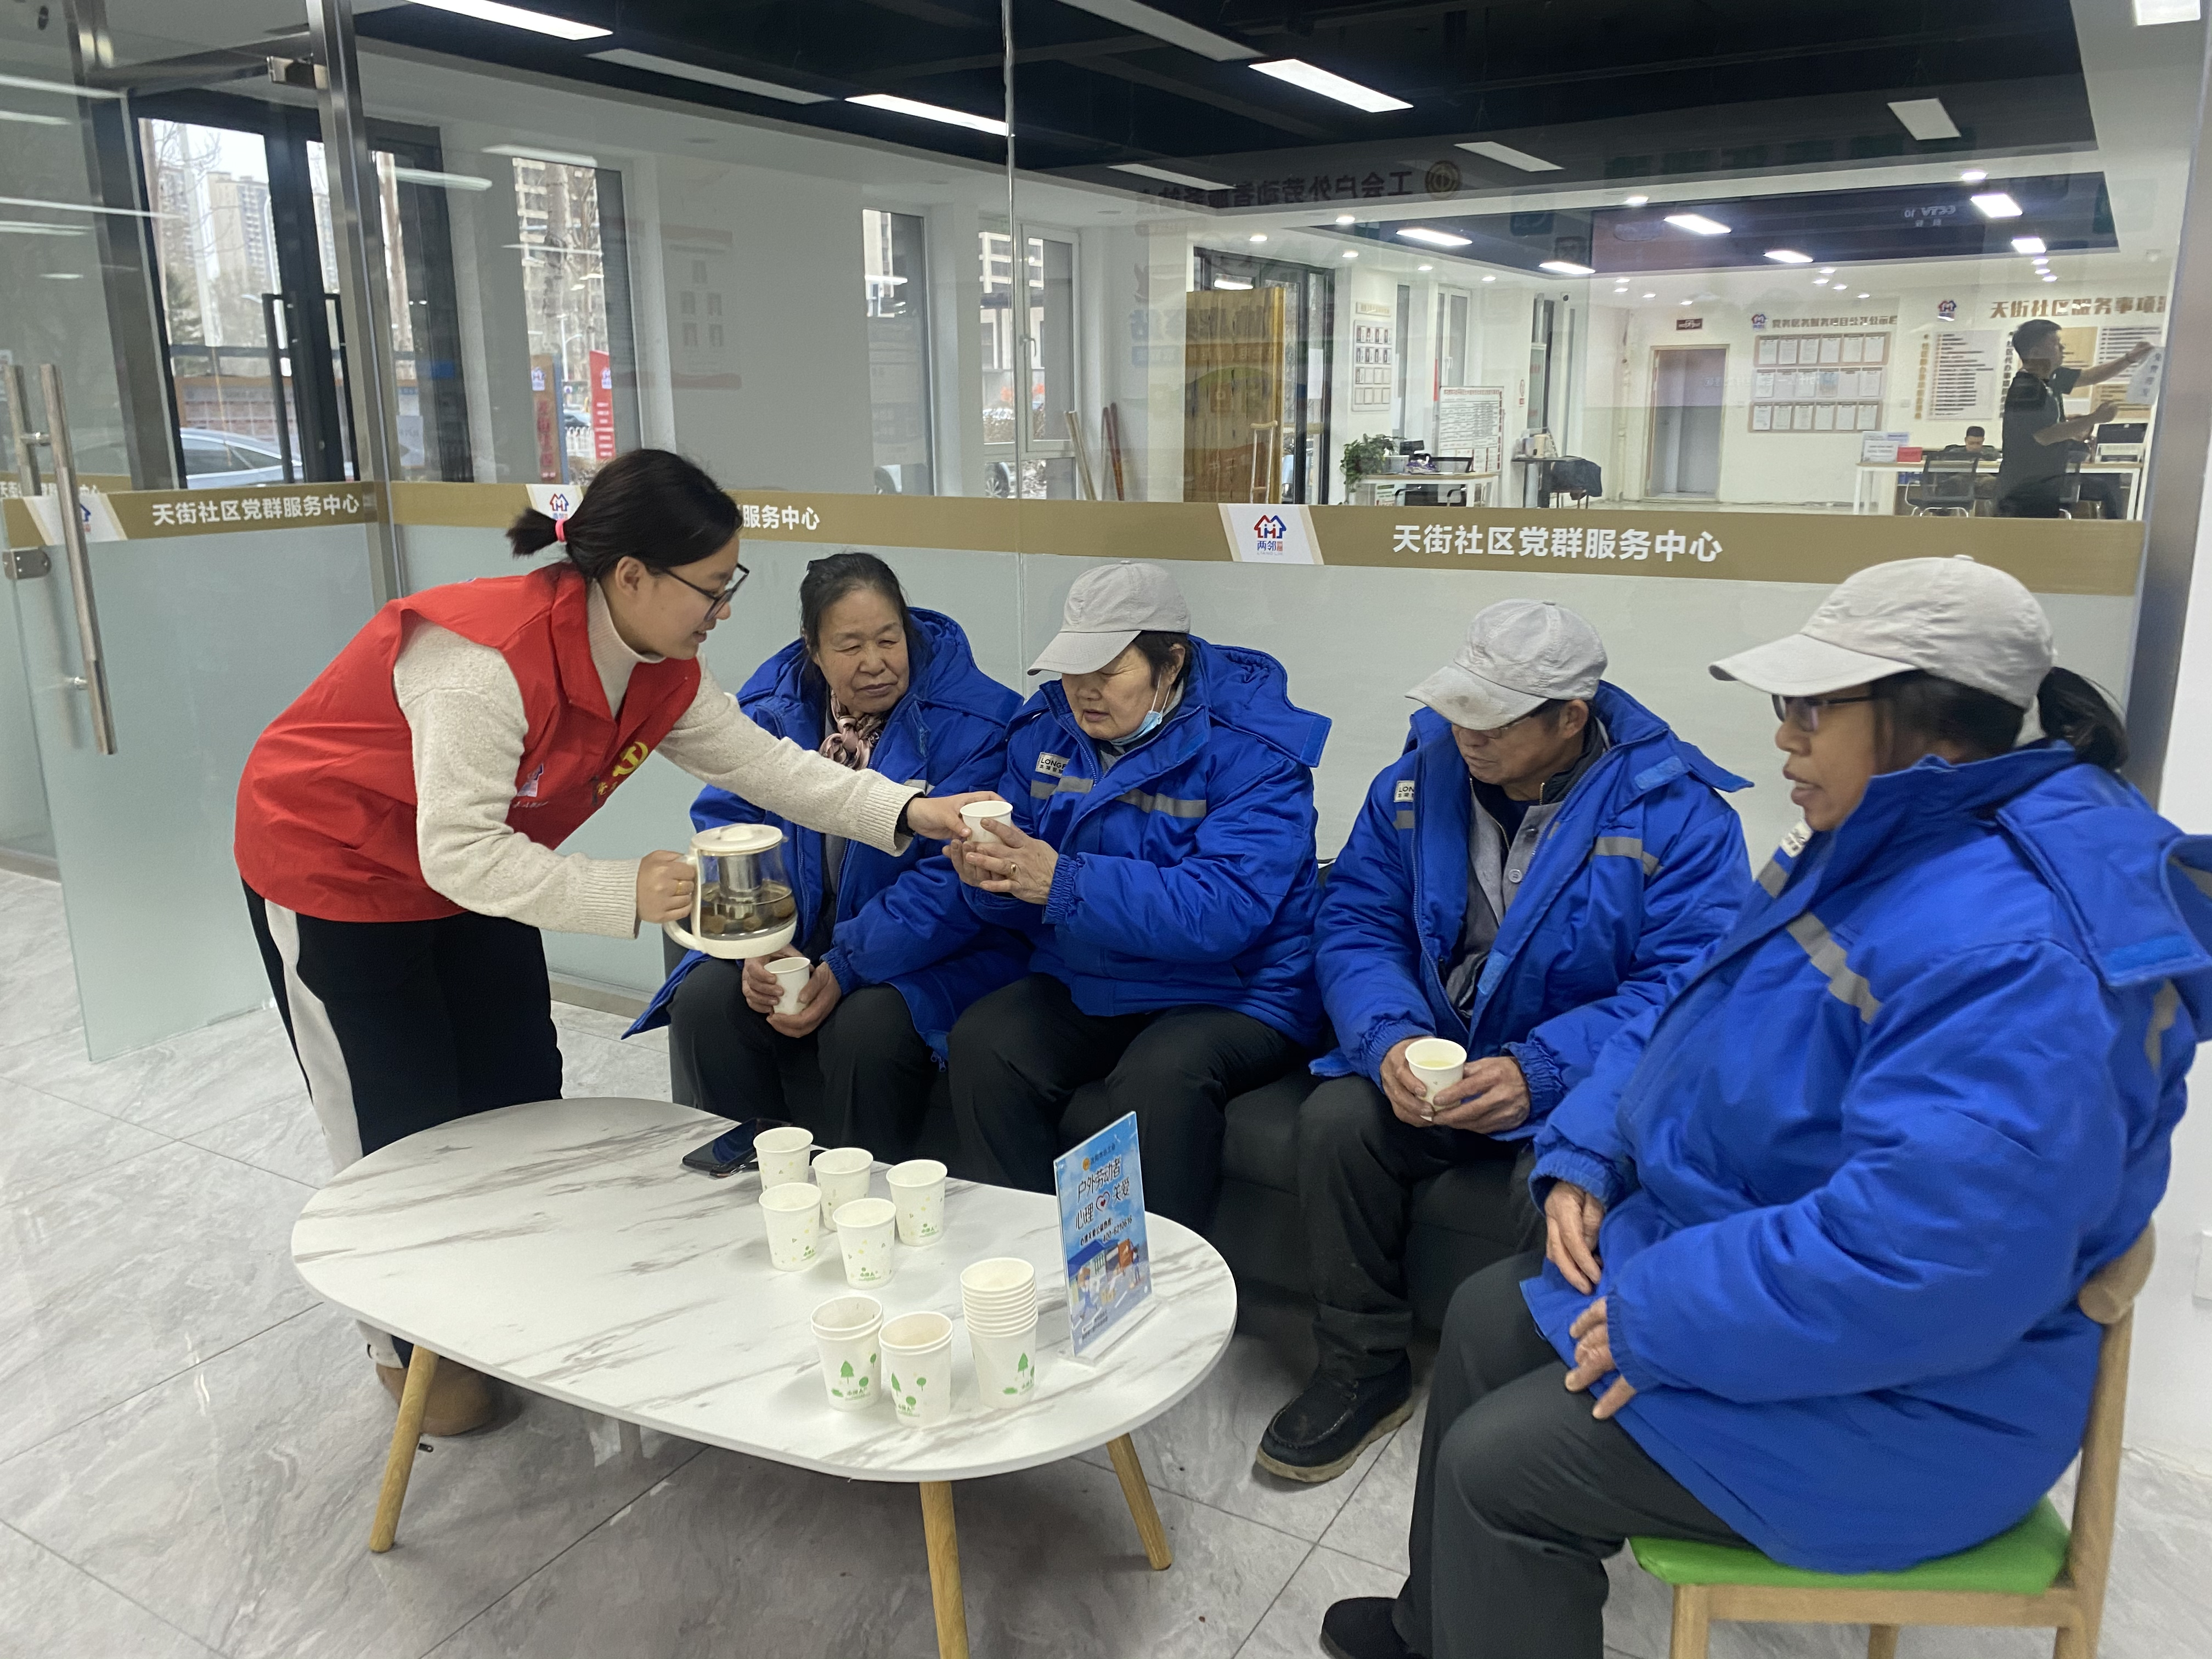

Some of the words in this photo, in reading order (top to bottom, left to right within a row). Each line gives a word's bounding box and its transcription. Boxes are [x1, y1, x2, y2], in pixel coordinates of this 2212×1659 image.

[152, 494, 359, 525] 天街社区党群服务中心
[737, 504, 820, 531] 服务中心
[1257, 540, 1277, 551] 两邻
[1392, 524, 1723, 563] 天街社区党群服务中心
[1078, 1156, 1121, 1202] 户外劳动者
[1076, 1202, 1094, 1230] 心理
